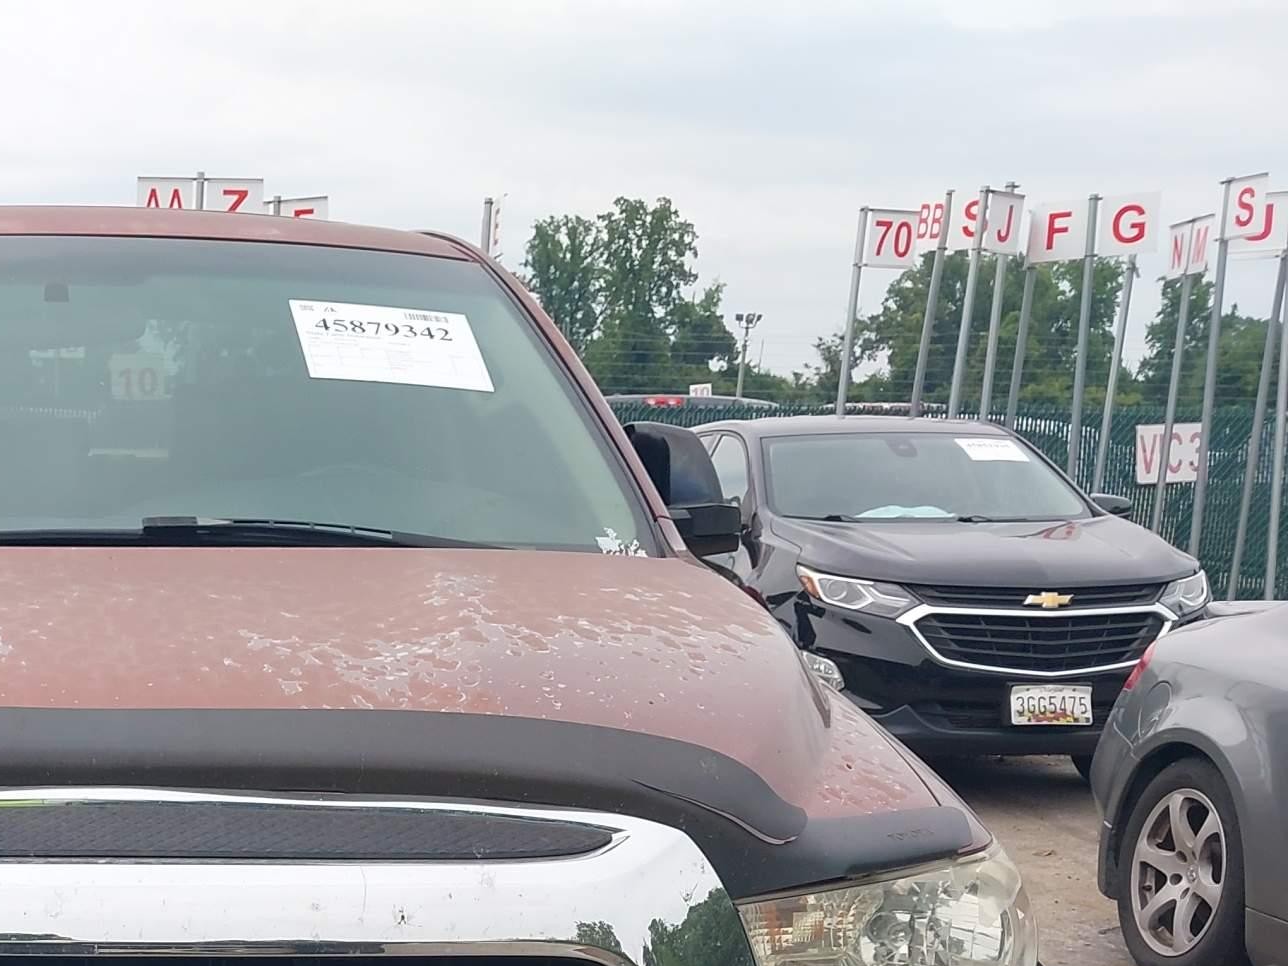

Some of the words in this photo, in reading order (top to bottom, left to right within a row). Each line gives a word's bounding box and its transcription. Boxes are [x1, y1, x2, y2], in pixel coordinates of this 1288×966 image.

[917, 203, 944, 239] BB
[997, 204, 1014, 242] J
[1112, 204, 1146, 244] G
[1235, 186, 1255, 227] S
[1244, 203, 1274, 241] J
[875, 220, 912, 258] 70
[1045, 211, 1073, 251] F
[1172, 232, 1184, 270] N
[314, 317, 453, 342] 45879342
[119, 367, 158, 396] 10
[1016, 695, 1088, 715] 3GG5475
